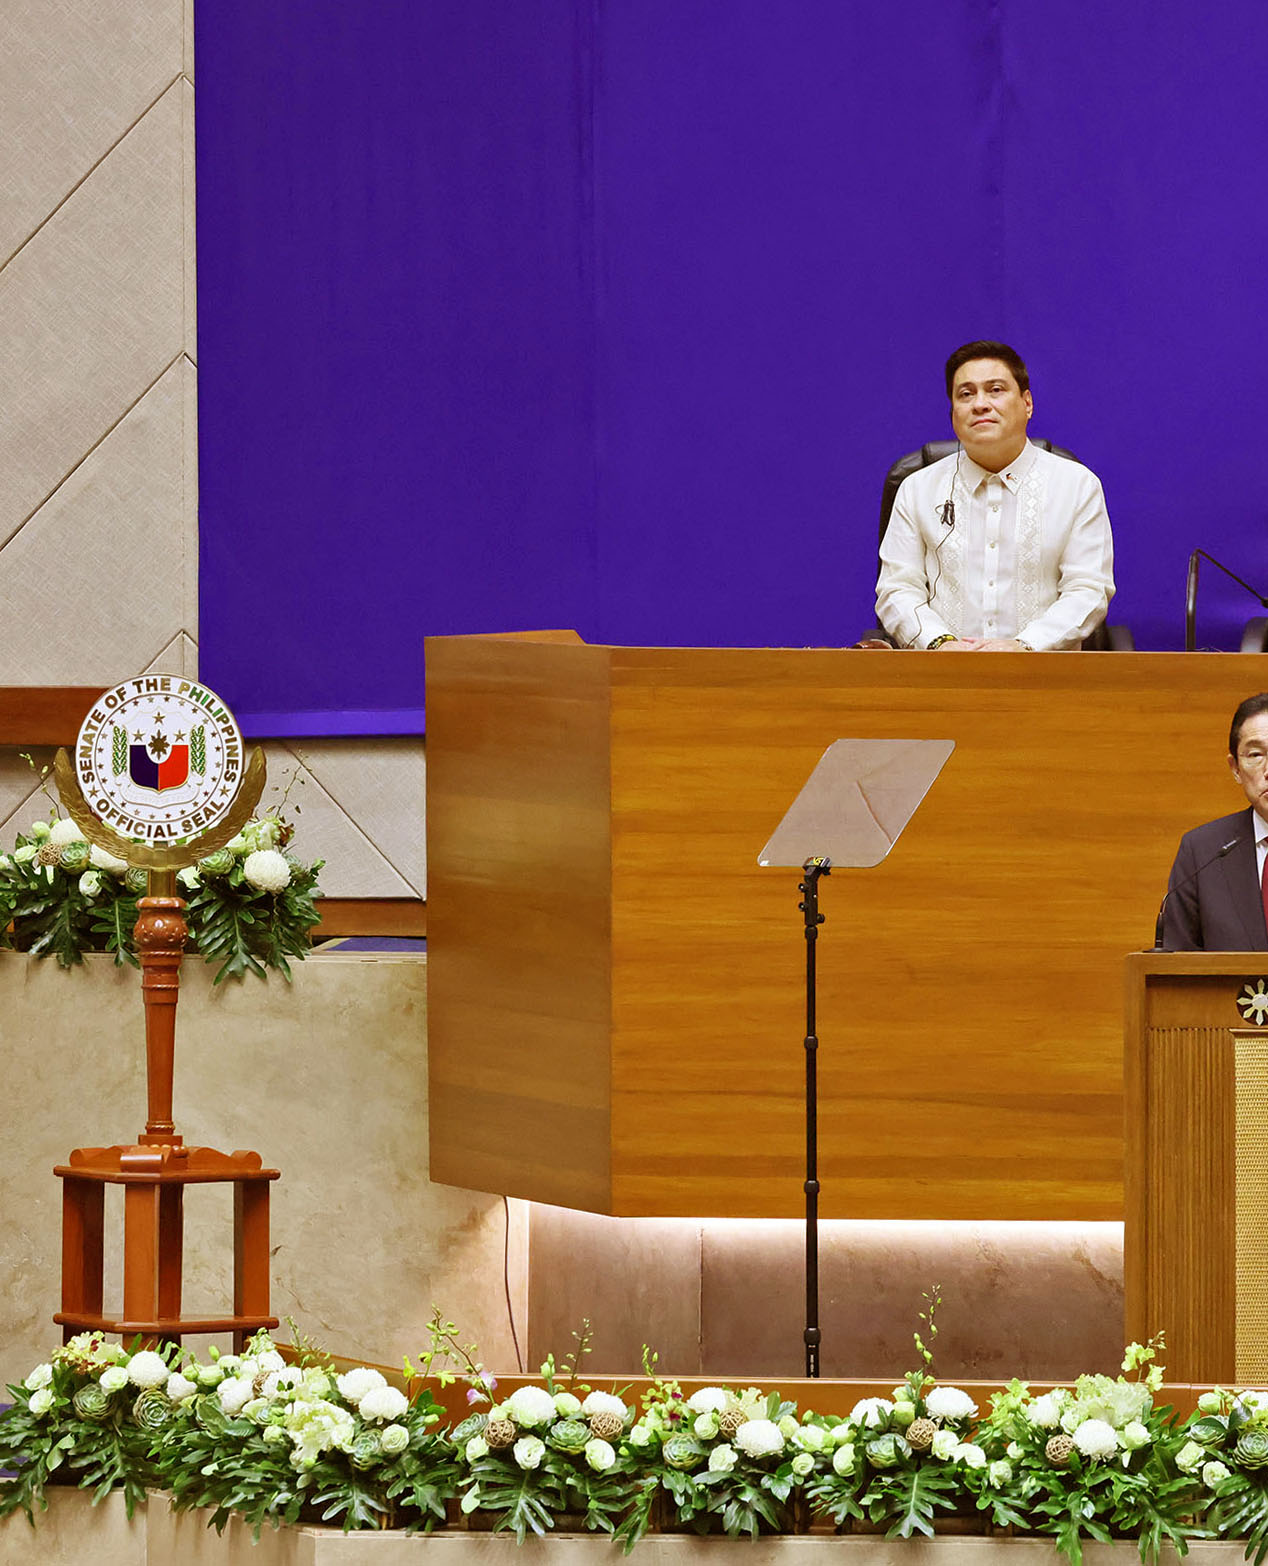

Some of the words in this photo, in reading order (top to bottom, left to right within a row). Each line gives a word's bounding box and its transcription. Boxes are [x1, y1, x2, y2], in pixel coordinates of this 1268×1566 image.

[79, 709, 106, 784] SENATE
[104, 687, 127, 711] OF
[132, 677, 171, 694] THE
[177, 682, 239, 783] PHILIPPINES
[96, 798, 178, 838] OFFICIAL
[181, 799, 225, 833] SEAL
